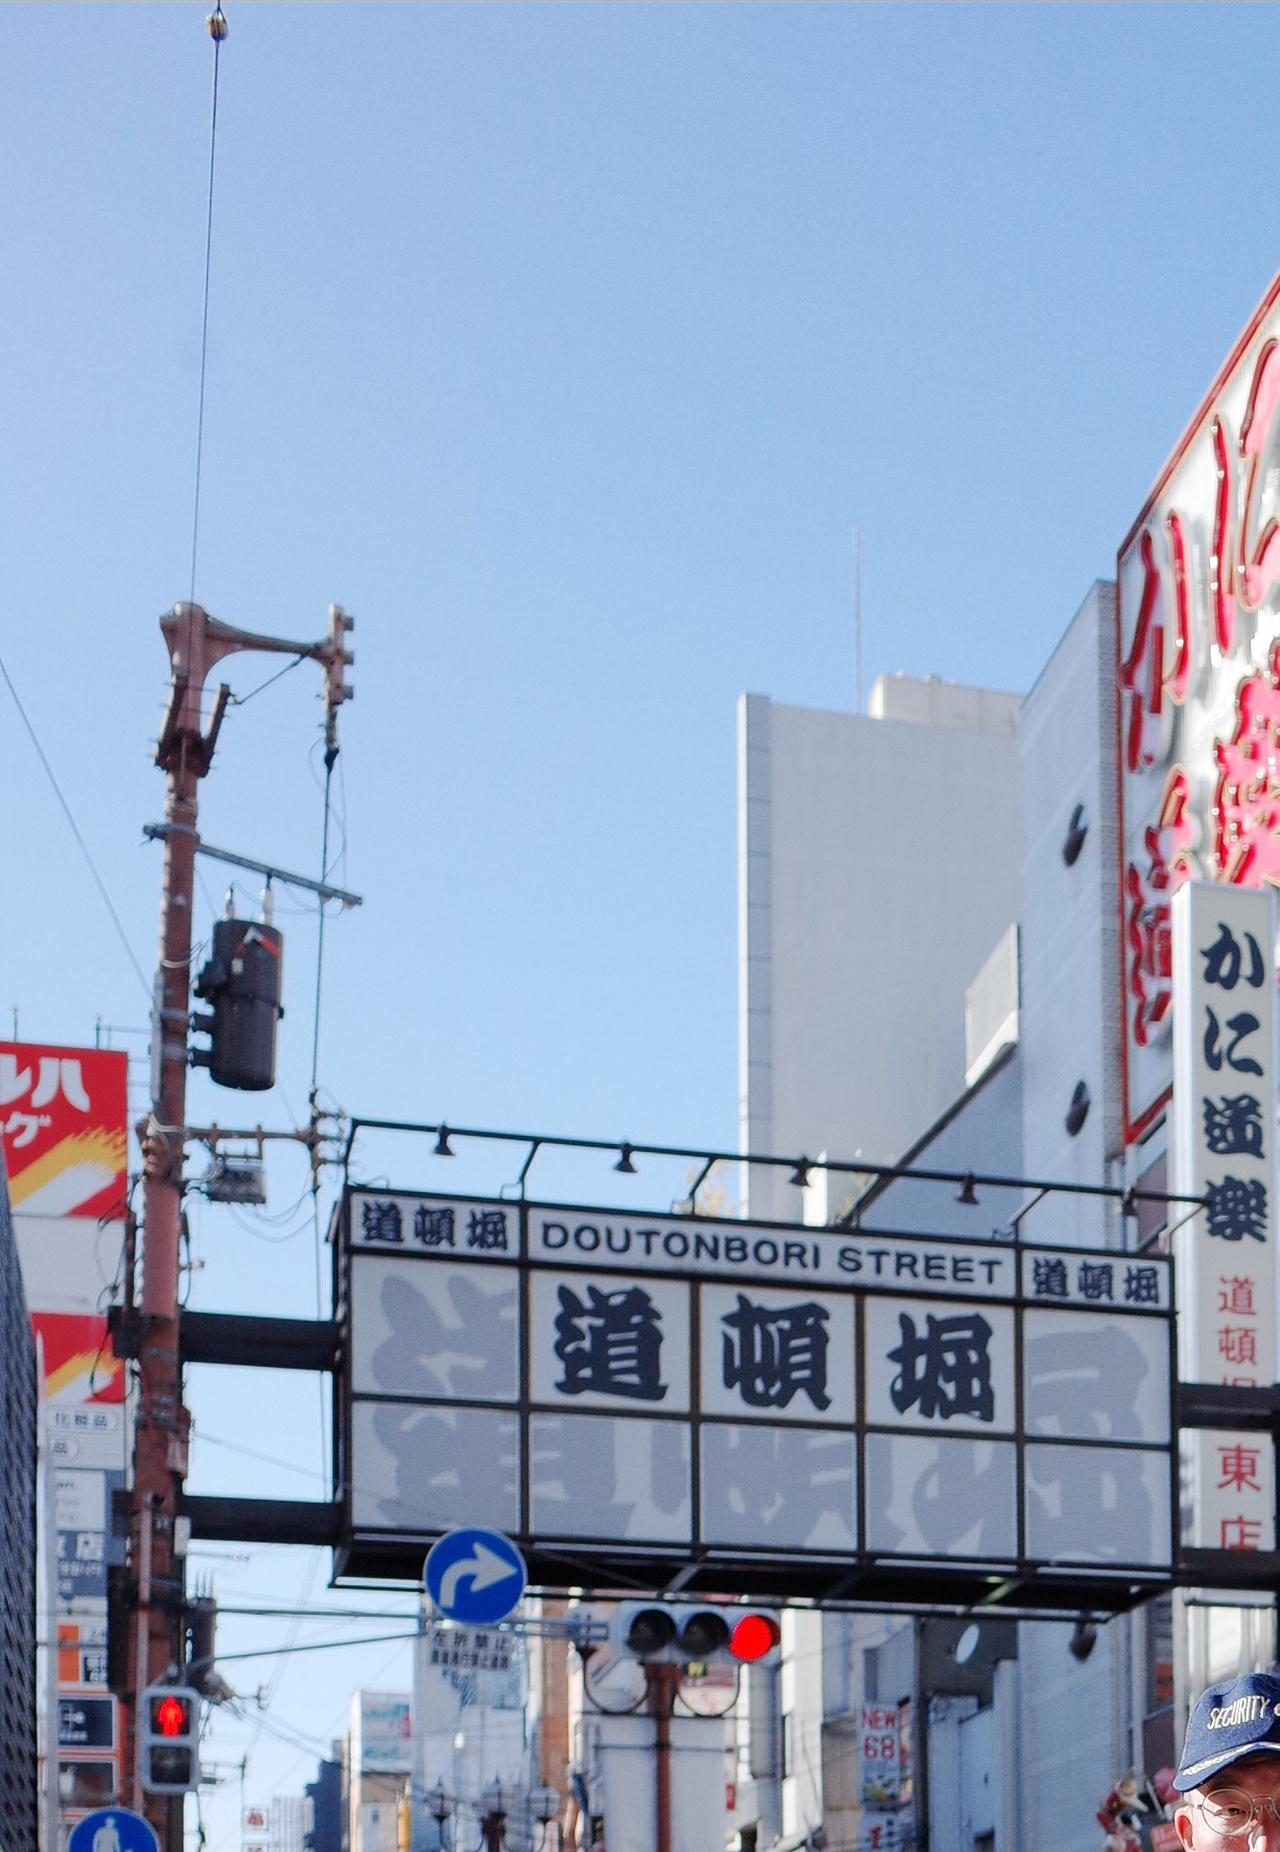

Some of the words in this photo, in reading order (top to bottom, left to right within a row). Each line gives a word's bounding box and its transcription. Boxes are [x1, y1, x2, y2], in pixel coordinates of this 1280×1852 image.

[1200, 923, 1268, 1243] かに道樂
[361, 1200, 510, 1251] 道頓堀
[541, 1223, 821, 1268] DOUTONBORI
[838, 1247, 1003, 1286] STREET
[1031, 1257, 1161, 1305] 道頓堀
[552, 1283, 996, 1424] 道頓堀
[1217, 1275, 1262, 1550] 道頓東店
[862, 1707, 896, 1729] NEW
[1207, 1694, 1271, 1730] SECURITY
